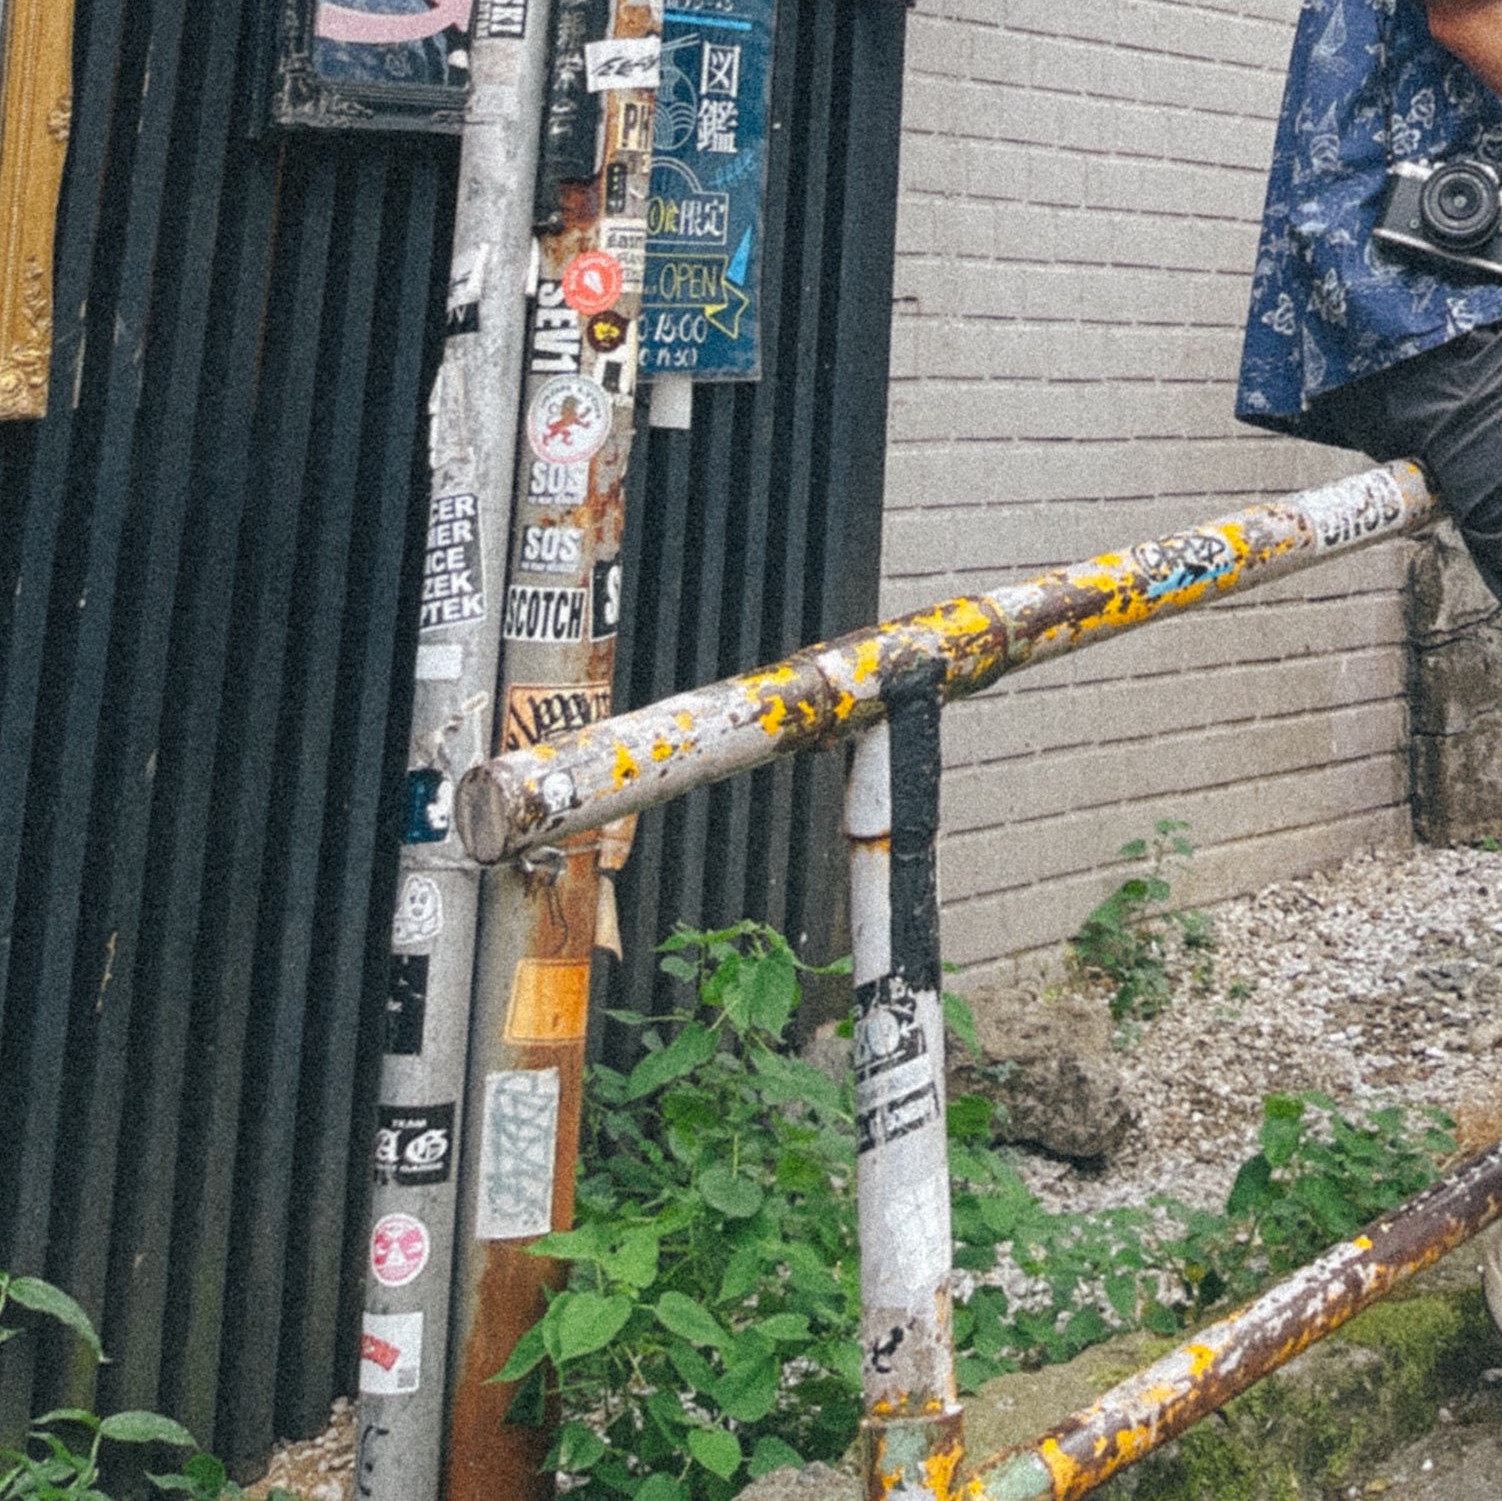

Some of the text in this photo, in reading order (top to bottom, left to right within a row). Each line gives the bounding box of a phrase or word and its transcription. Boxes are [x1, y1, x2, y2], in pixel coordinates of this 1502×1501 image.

[696, 40, 742, 154] 図鑑
[659, 262, 718, 300] OPEN
[523, 525, 584, 562] SOS
[505, 587, 586, 640] SCOTCH
